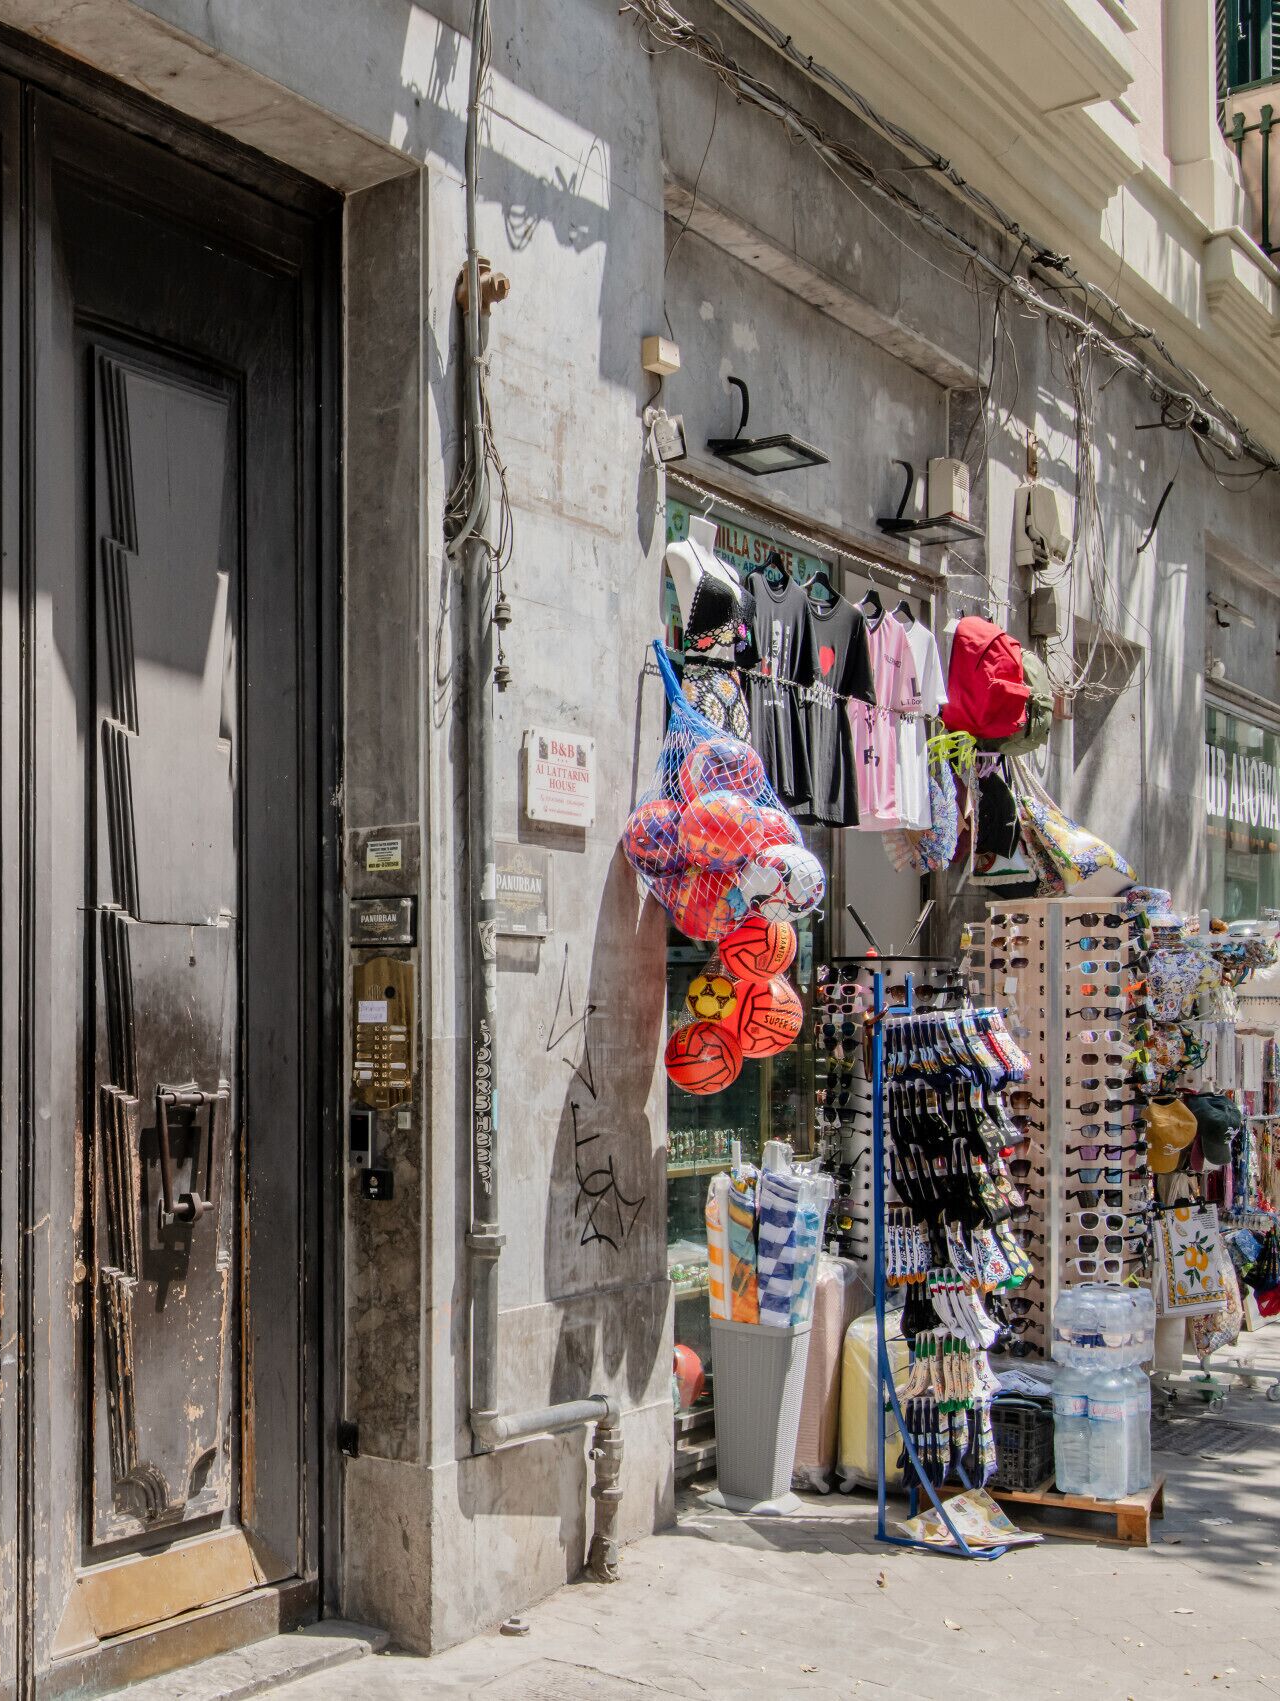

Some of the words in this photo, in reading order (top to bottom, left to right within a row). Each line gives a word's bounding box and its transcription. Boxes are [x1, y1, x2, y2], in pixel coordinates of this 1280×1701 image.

[754, 538, 793, 575] STRE
[551, 741, 575, 758] B&B
[547, 765, 589, 783] LATTARINI
[549, 778, 577, 793] HOUSE
[496, 873, 542, 894] PANURBAN
[360, 913, 397, 923] PANURBAN
[763, 1014, 789, 1030] SUPER
